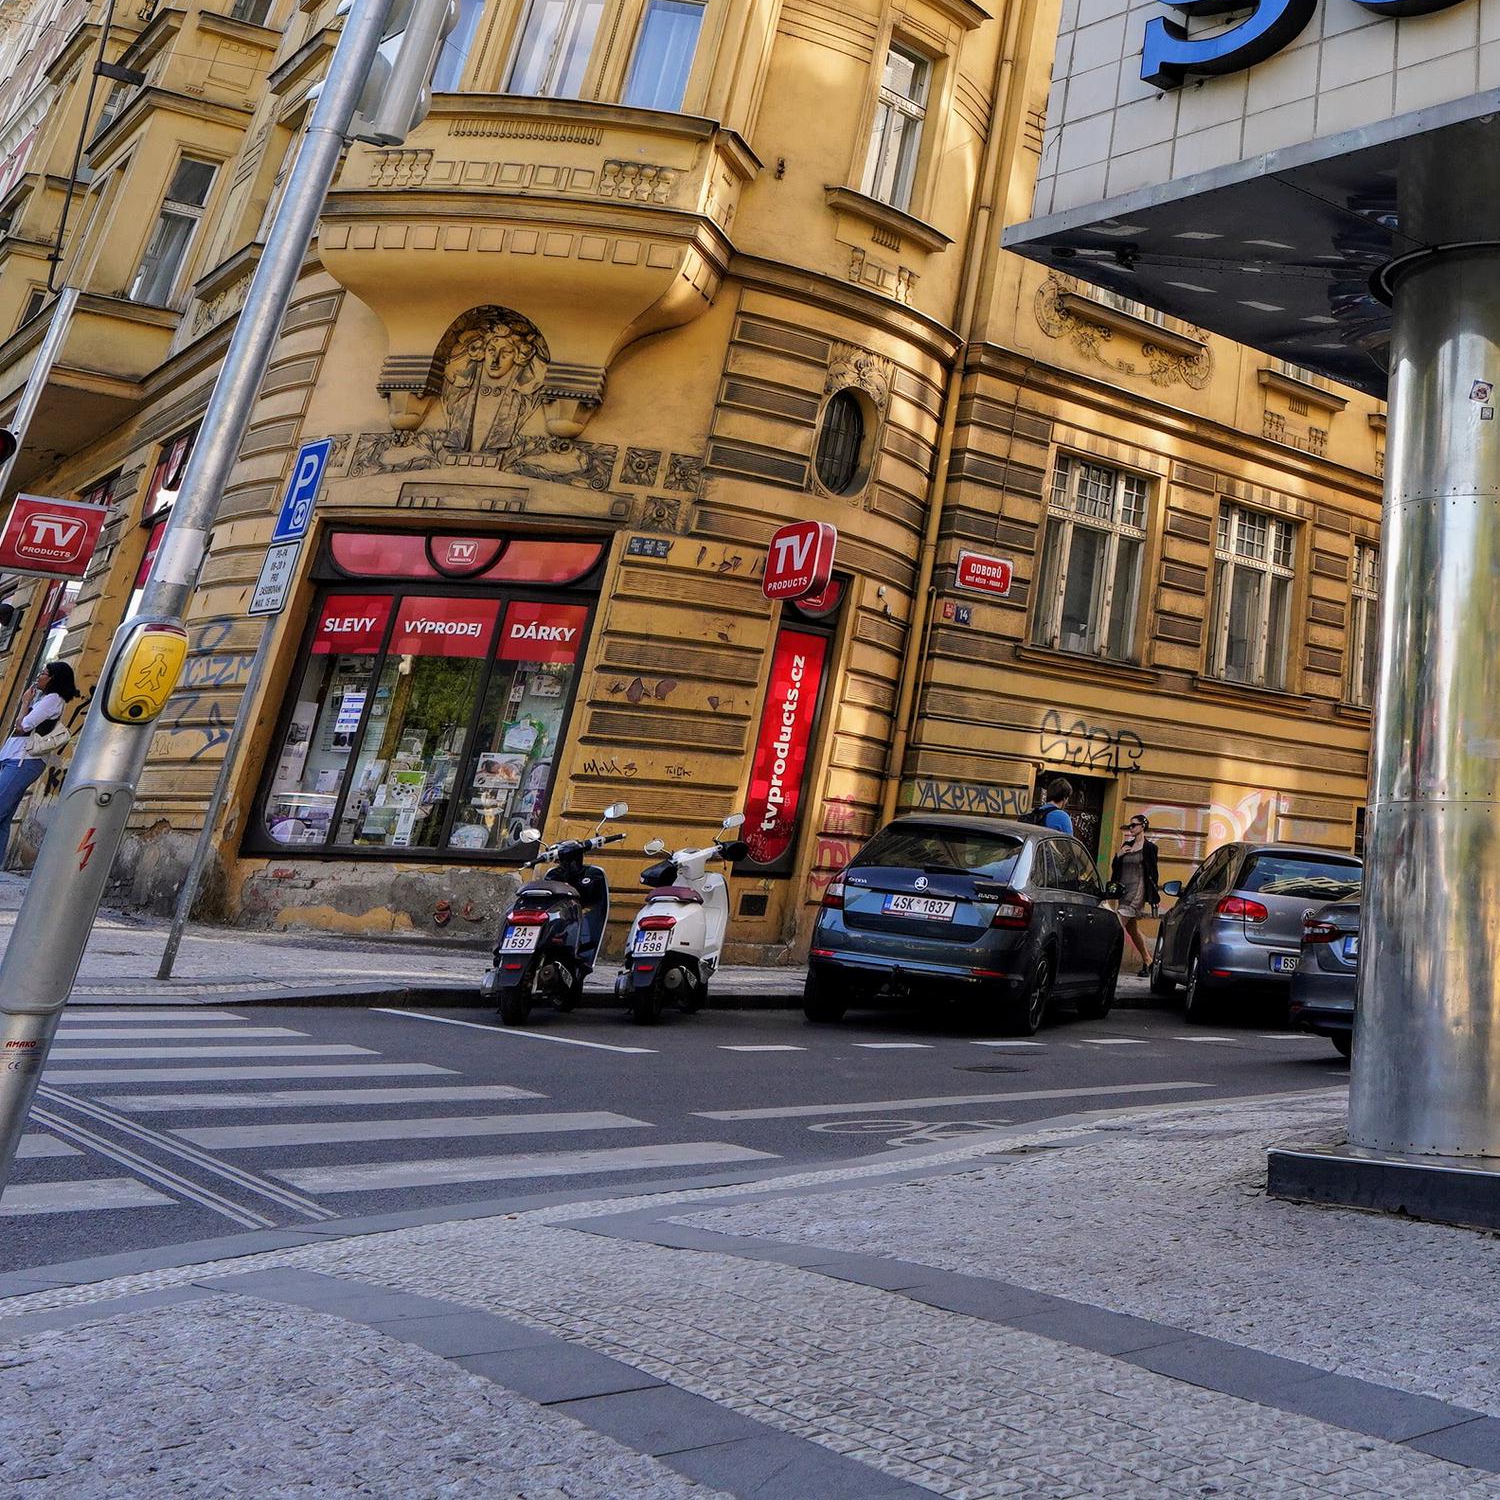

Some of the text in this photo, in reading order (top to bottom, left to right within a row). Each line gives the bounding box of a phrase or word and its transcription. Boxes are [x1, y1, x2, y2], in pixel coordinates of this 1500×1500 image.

[31, 520, 80, 547] TV
[21, 545, 71, 558] PRODUCTS
[453, 544, 475, 557] TV
[774, 531, 815, 575] TV
[970, 563, 1002, 579] ODBORŮ
[767, 576, 808, 592] PRODUCTS
[959, 609, 968, 621] 14
[323, 617, 376, 633] SLEVY
[404, 617, 482, 638] VÝPRODEJ
[510, 621, 577, 642] DÁRKY
[760, 654, 806, 831] tvproducts.cz
[893, 894, 950, 915] 4SK 1837
[514, 927, 527, 938] 2A
[644, 932, 658, 942] 2A
[505, 938, 532, 949] 1597
[635, 943, 661, 953] 1598
[6, 1040, 37, 1048] AMAKO
